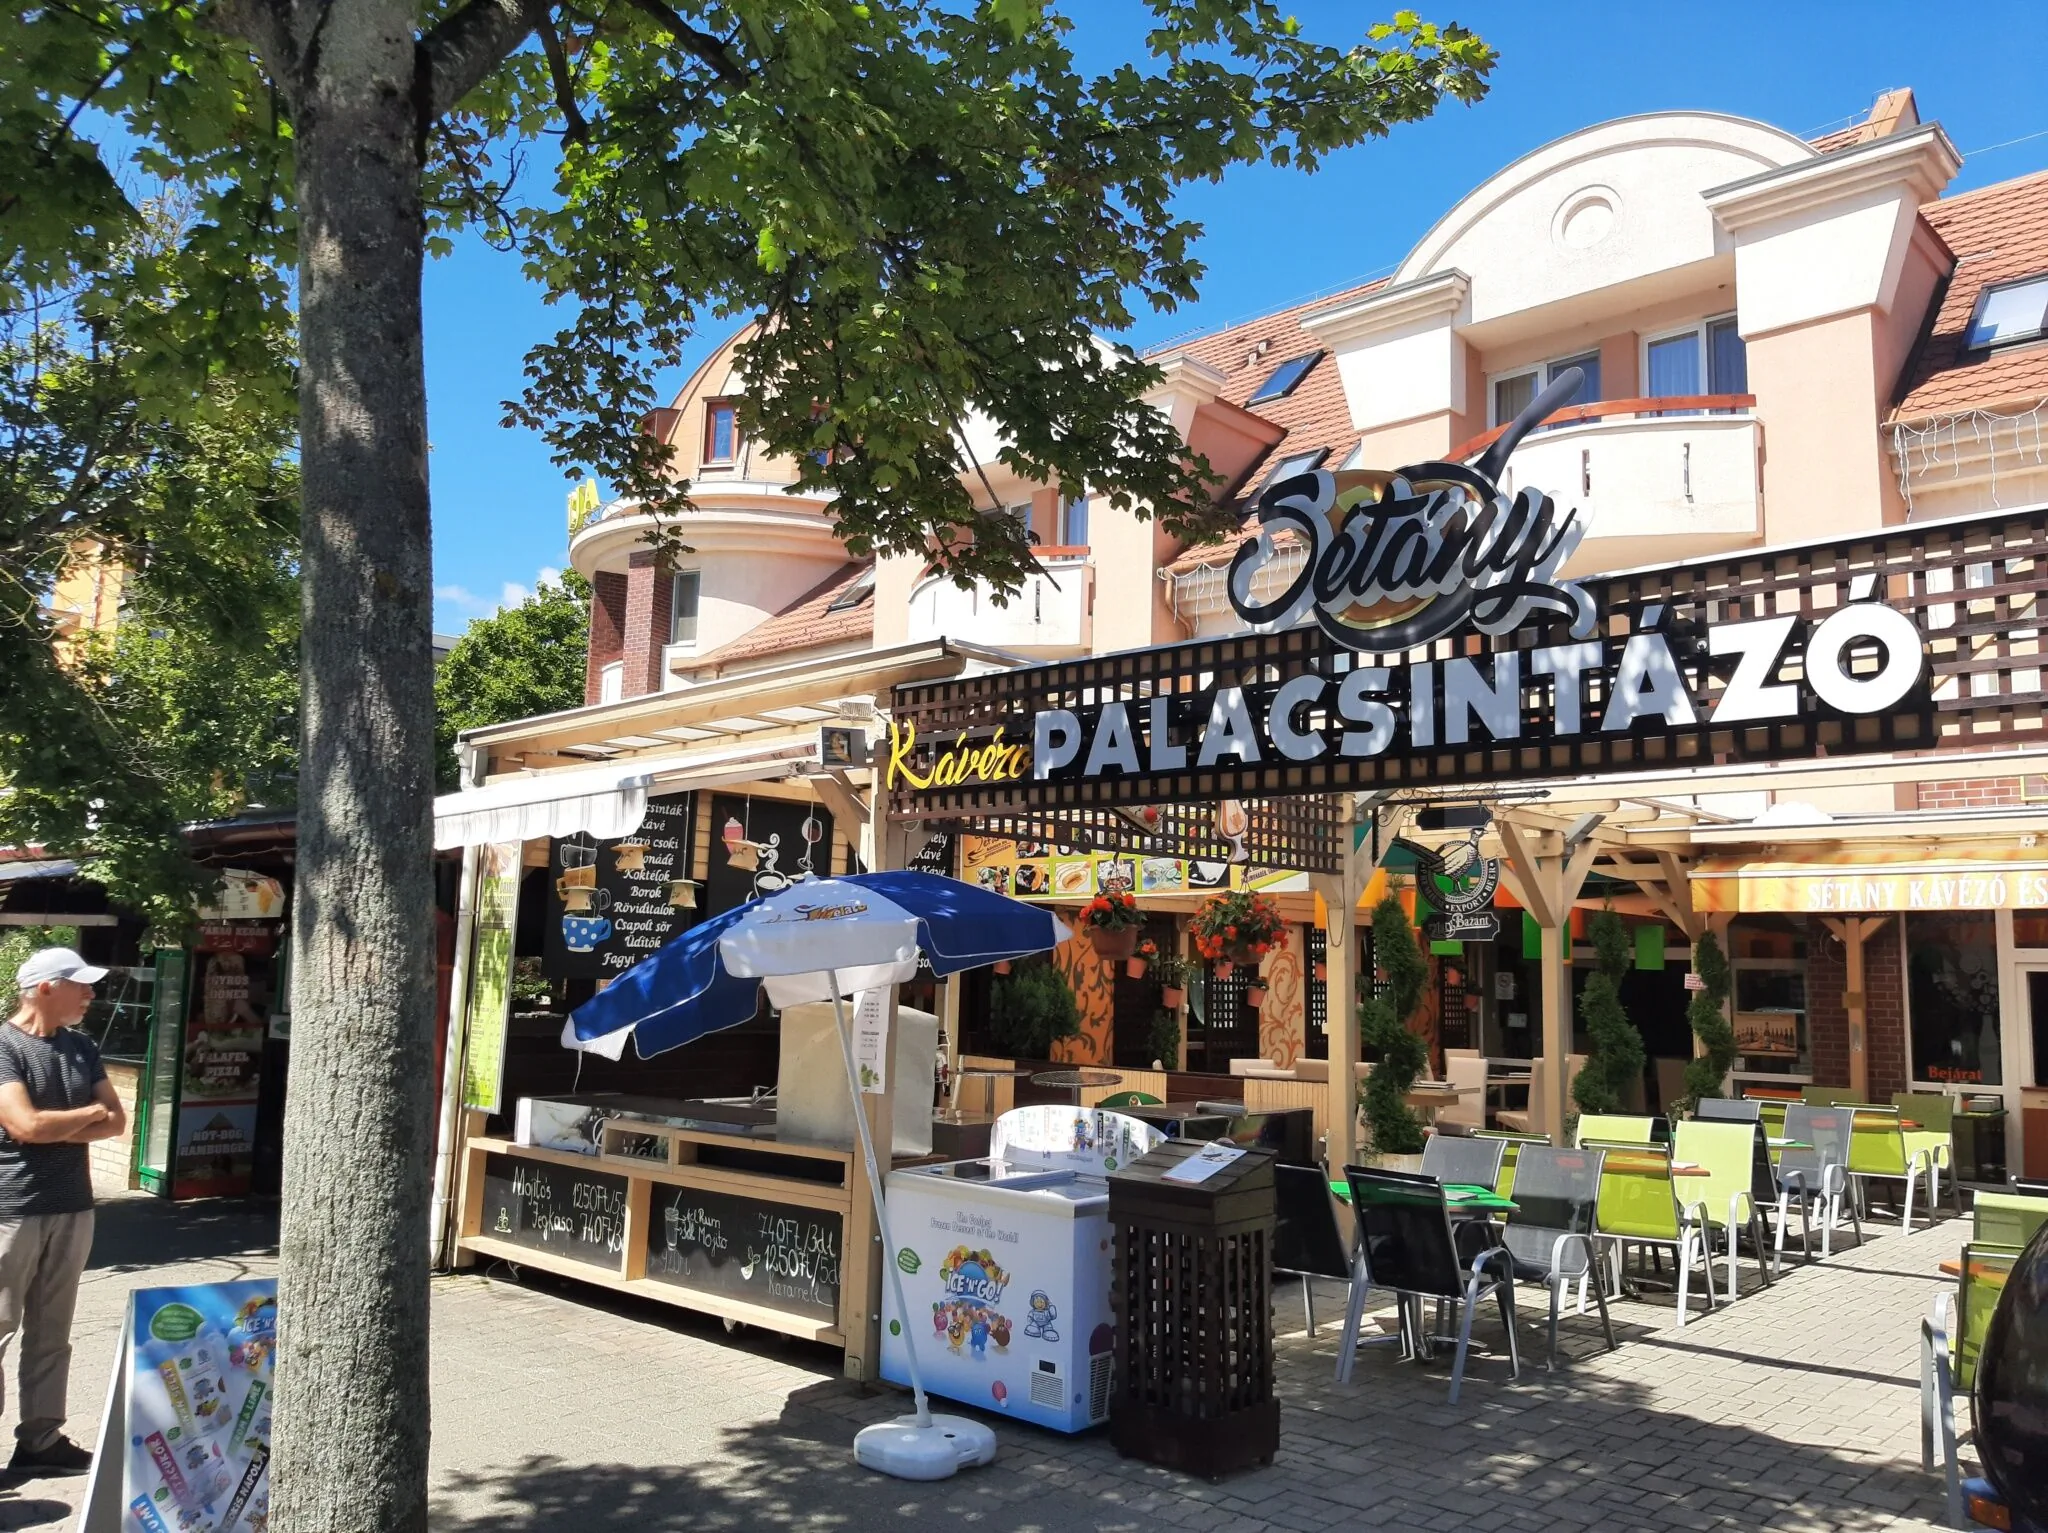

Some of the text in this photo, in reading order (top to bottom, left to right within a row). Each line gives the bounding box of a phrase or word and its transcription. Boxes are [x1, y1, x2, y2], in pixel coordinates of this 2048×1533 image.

[1227, 470, 1592, 635] Sétány
[1033, 572, 1922, 781] PALACSINTÁZÓ
[645, 803, 683, 816] csinták
[653, 836, 679, 849] csoki
[643, 853, 674, 866] onádé
[915, 848, 942, 861] Kávé
[623, 868, 670, 882] Koktélok
[1485, 867, 1496, 892] BEER
[631, 885, 662, 898] Borok
[1807, 873, 2048, 910] SÉTÁNY KÁVÉZÓ ÉS
[1450, 896, 1484, 912] EXPORT
[615, 918, 672, 934] Csapolt sör
[602, 952, 635, 968] Fagyi
[198, 1051, 249, 1064] FALAFEL
[205, 1065, 241, 1077] PIZZA
[1928, 1065, 1984, 1082] Bejárat
[192, 1129, 243, 1142] HOT-DOG
[180, 1142, 254, 1157] HAMBURGER
[698, 1207, 721, 1229] Rum
[698, 1226, 728, 1257] Mojito
[945, 1268, 965, 1294] ICE
[976, 1280, 1005, 1302] GO!
[243, 1317, 261, 1333] ICE
